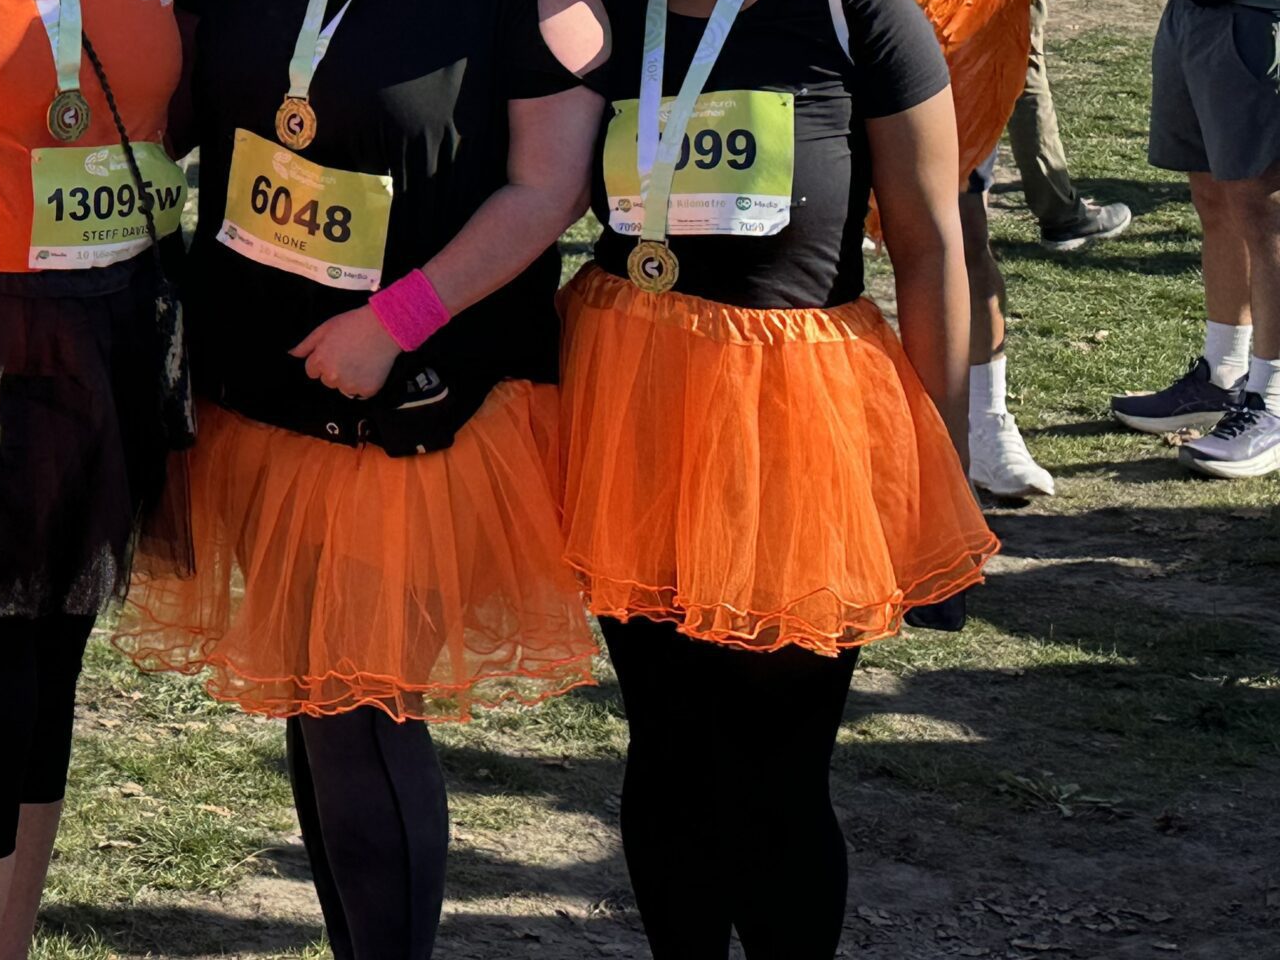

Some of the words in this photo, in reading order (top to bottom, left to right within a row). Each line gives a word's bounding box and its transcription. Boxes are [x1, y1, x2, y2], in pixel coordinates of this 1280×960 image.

[636, 129, 757, 171] 99
[251, 175, 352, 244] 6048
[274, 232, 308, 252] NONE
